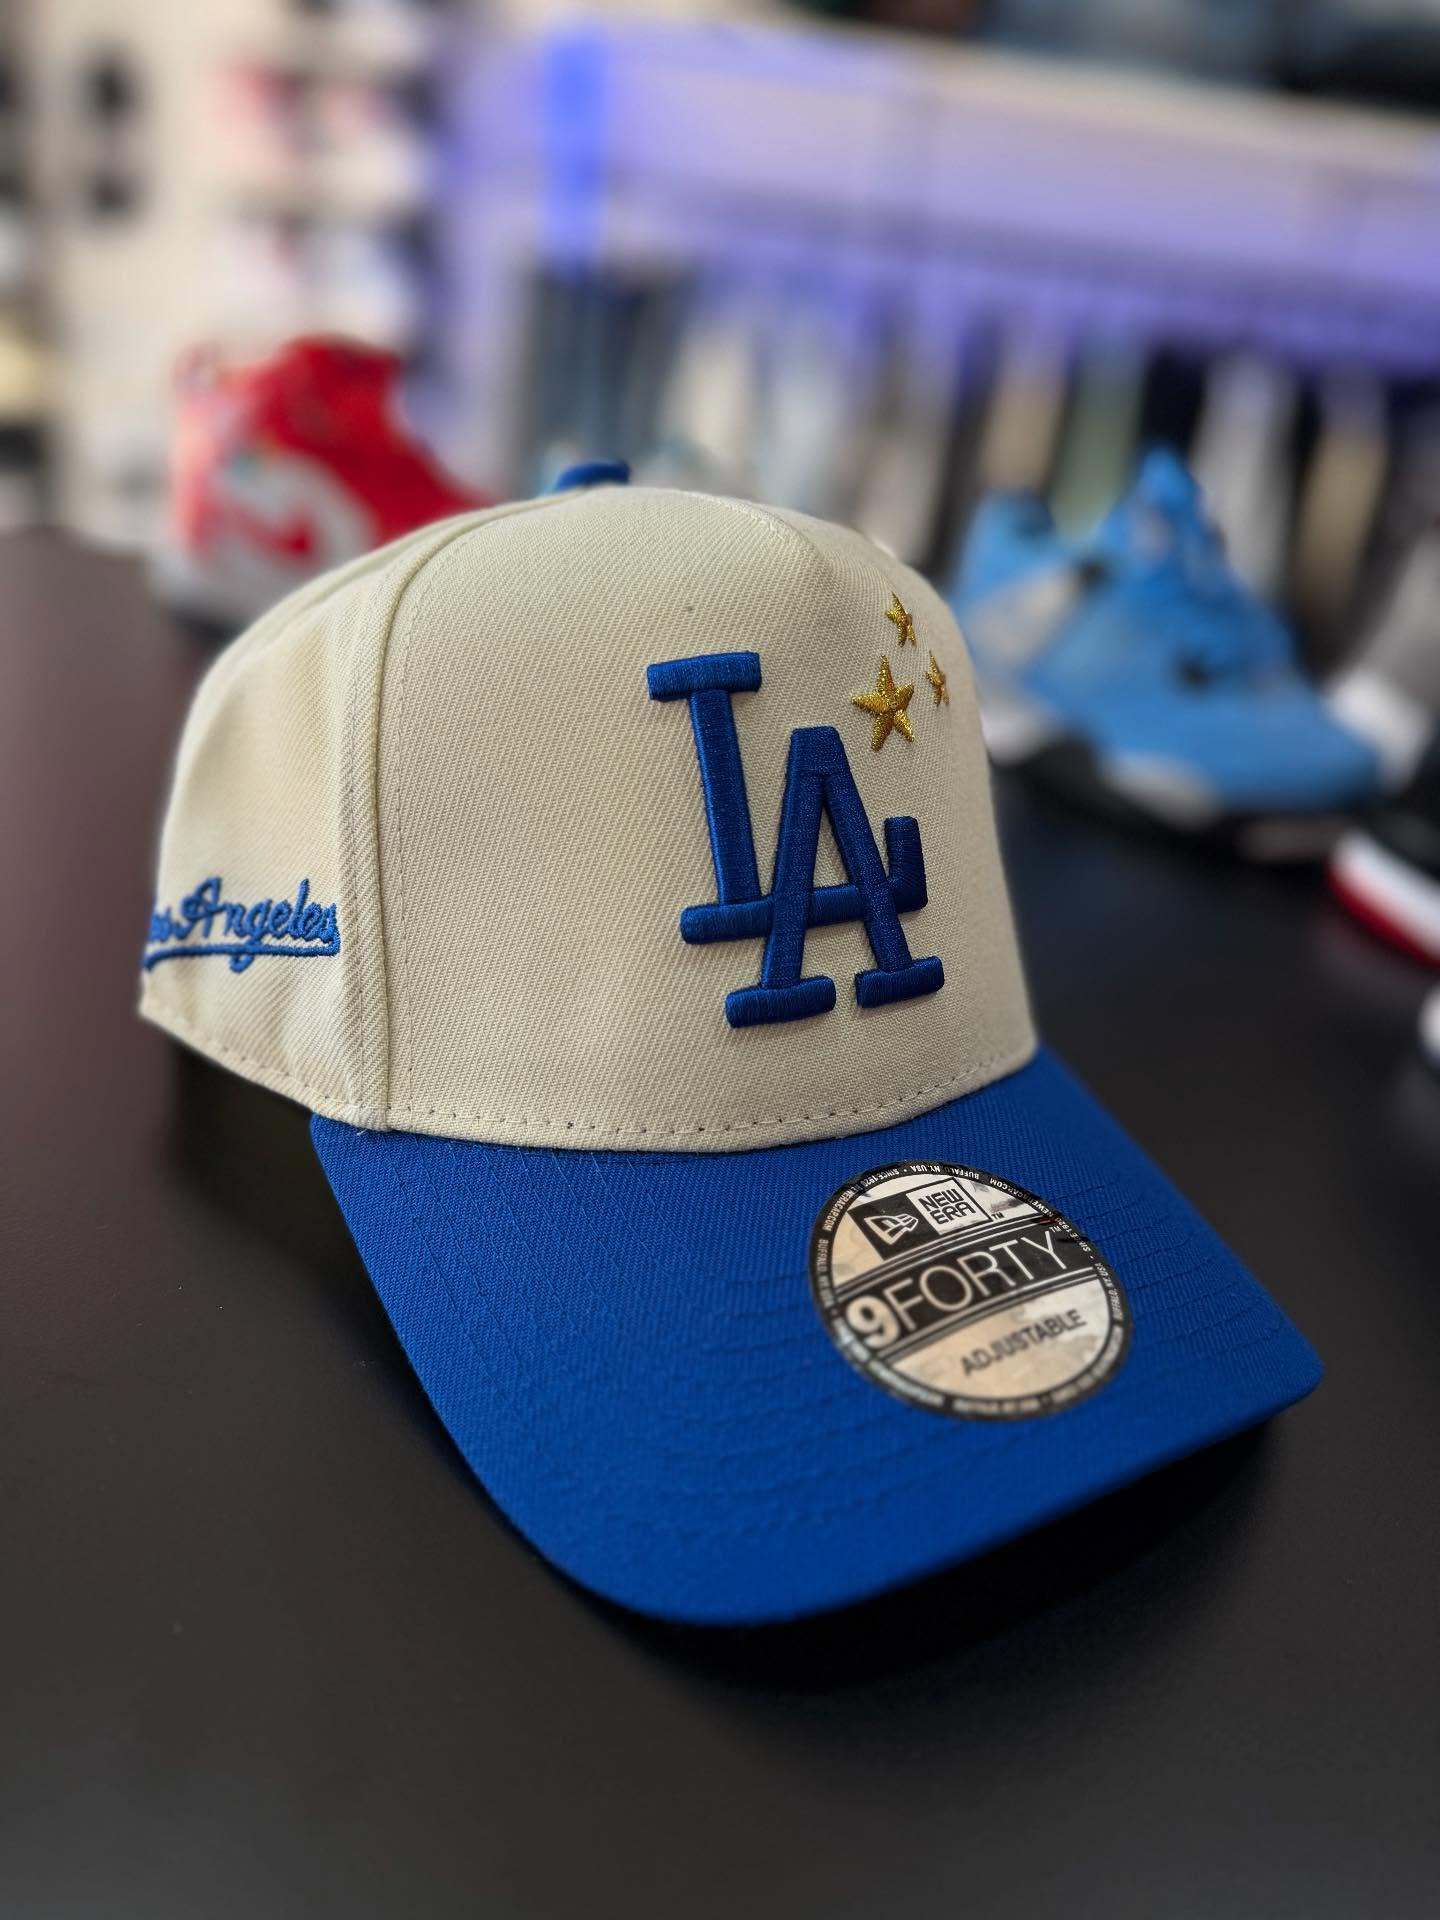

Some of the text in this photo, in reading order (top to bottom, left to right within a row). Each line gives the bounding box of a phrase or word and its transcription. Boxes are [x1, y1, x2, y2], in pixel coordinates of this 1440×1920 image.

[647, 651, 945, 1028] LA
[181, 876, 340, 973] Angeles
[910, 1164, 928, 1174] USA
[918, 1188, 966, 1212] NEW
[929, 1201, 977, 1225] ERA
[845, 1230, 1067, 1348] 9FORTY
[960, 1308, 1087, 1377] ADJUSTABLE
